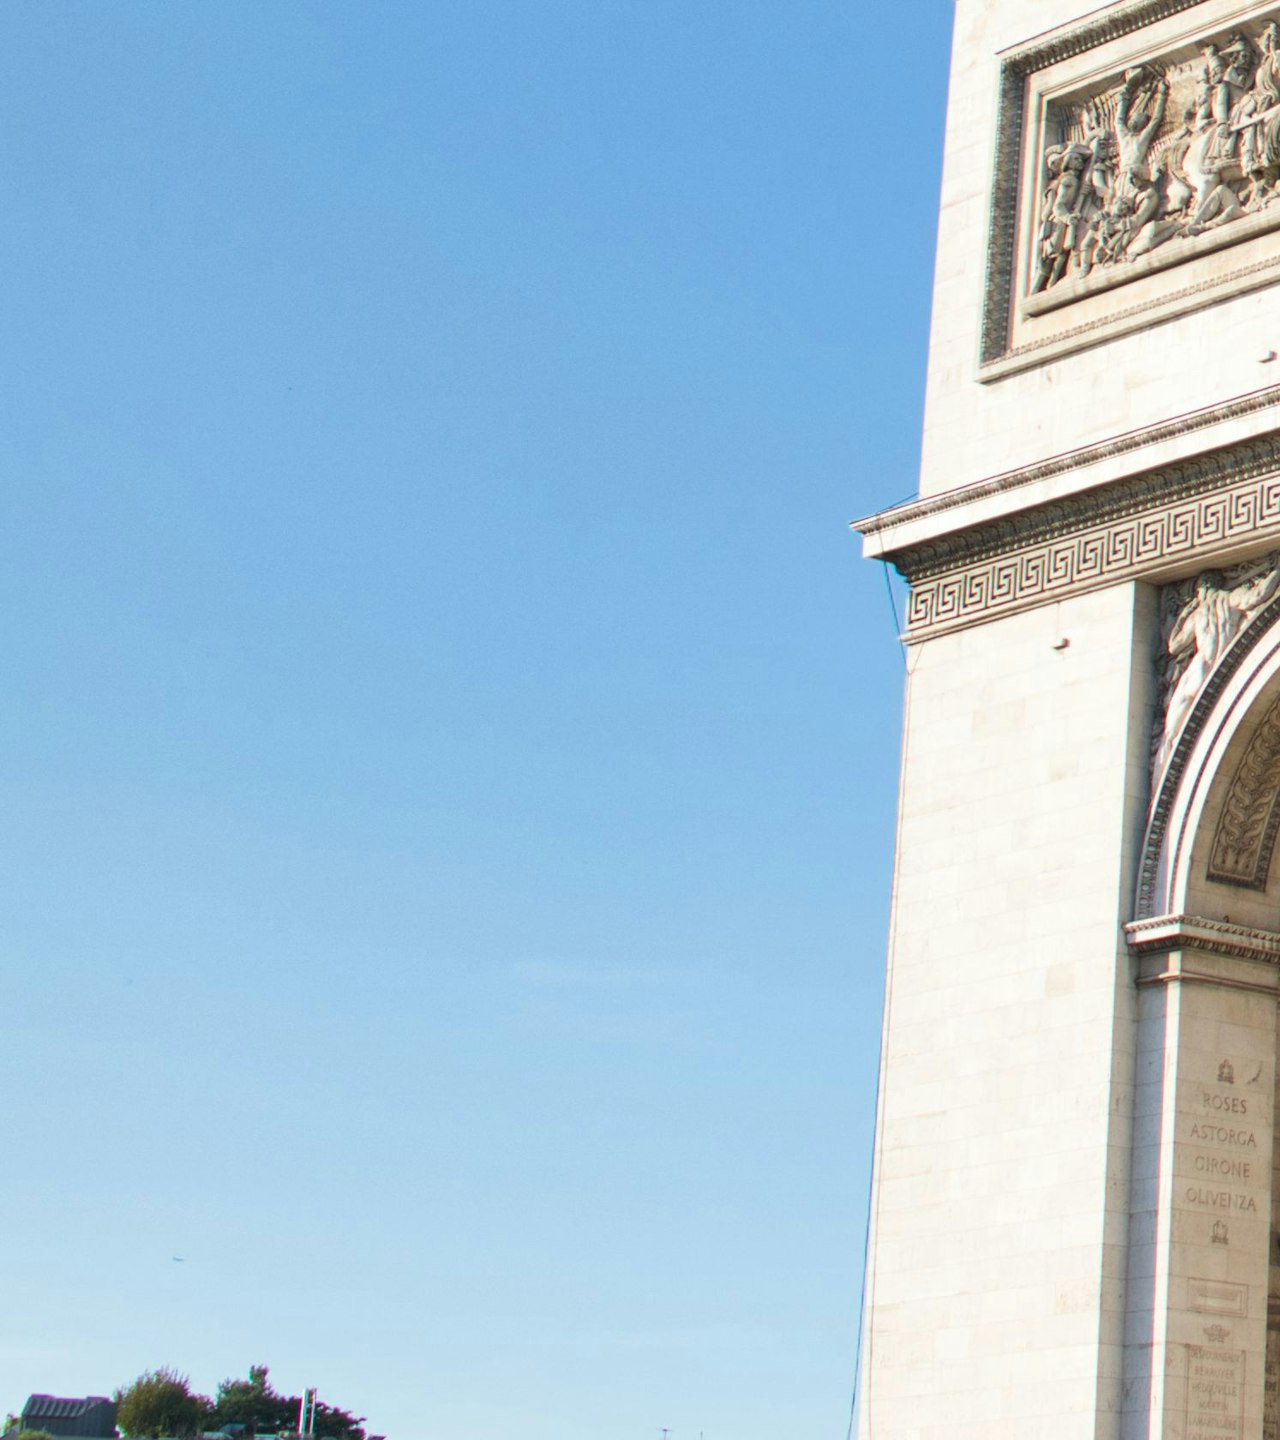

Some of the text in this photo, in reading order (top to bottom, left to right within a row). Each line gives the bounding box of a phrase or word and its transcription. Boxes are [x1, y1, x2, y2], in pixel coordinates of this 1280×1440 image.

[1203, 1093, 1247, 1115] ROSES
[1190, 1123, 1256, 1148] ASTORGA
[1195, 1155, 1250, 1178] GIRONE
[1186, 1187, 1256, 1212] OLIVENZA
